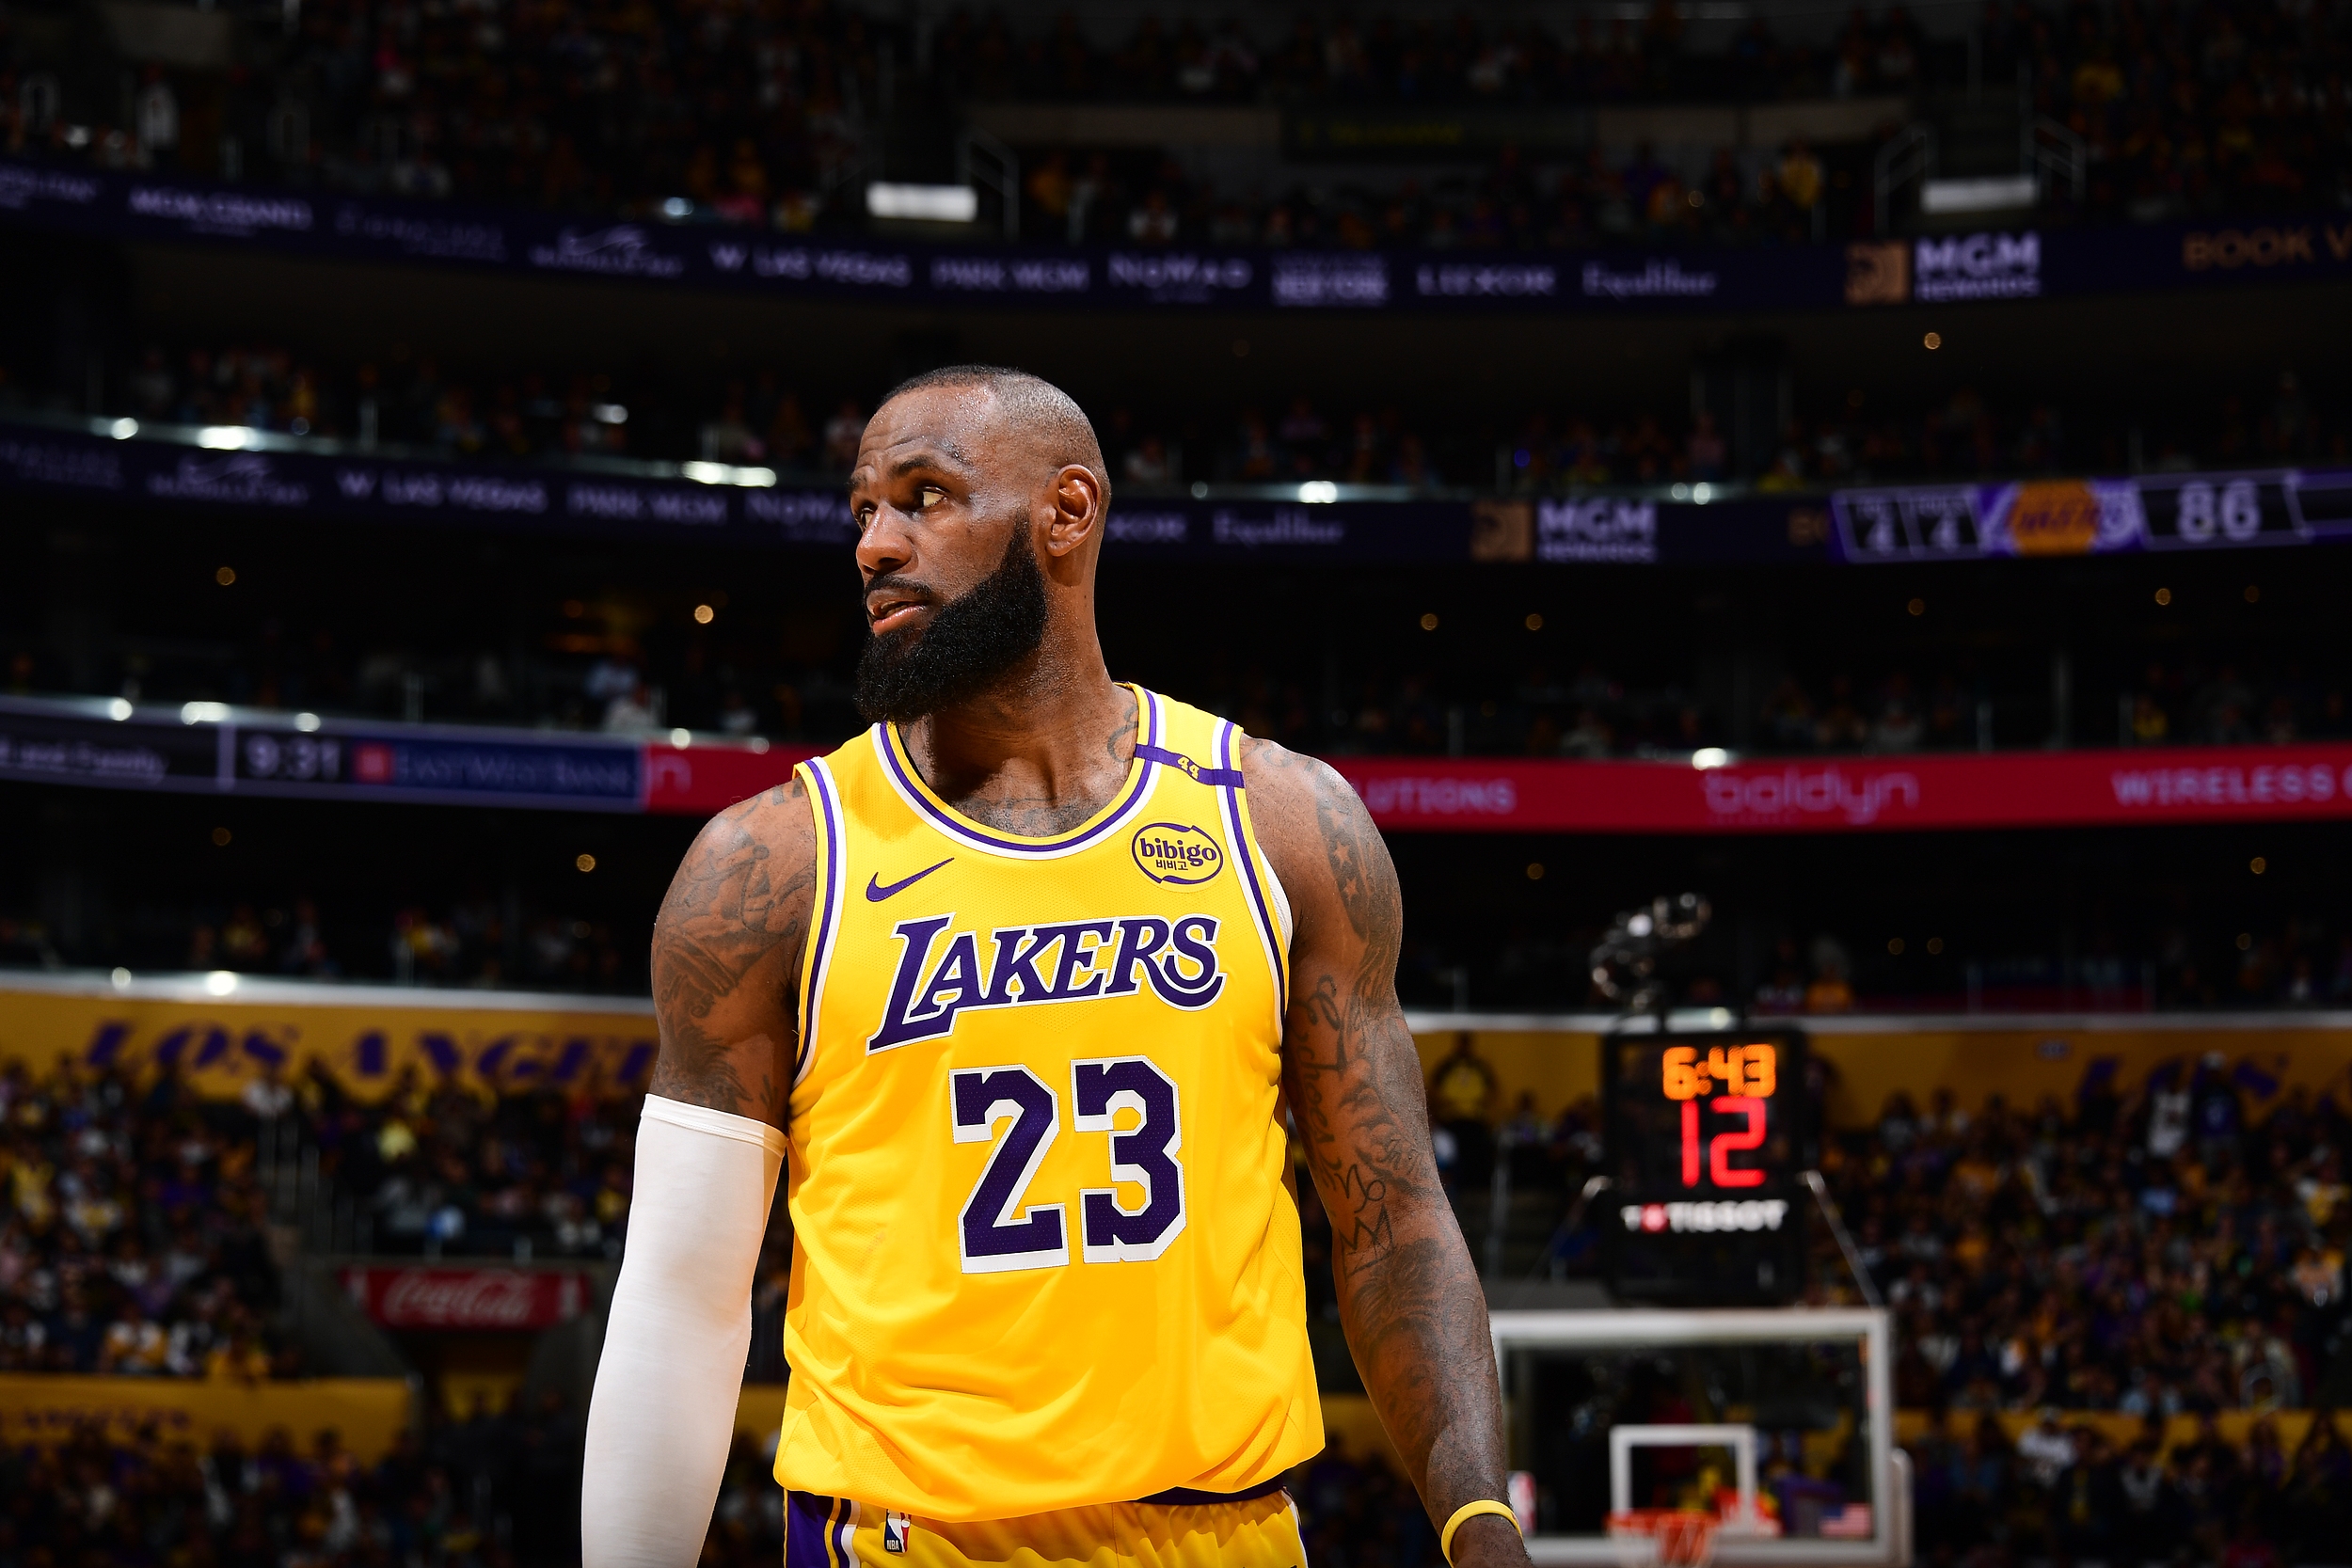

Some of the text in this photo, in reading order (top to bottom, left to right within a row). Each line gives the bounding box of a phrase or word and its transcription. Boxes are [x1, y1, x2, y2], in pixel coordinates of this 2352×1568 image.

[1915, 230, 2042, 277] MGM
[2181, 224, 2314, 274] BOOK
[1536, 496, 1657, 543] MGM
[2175, 479, 2262, 543] 86
[246, 735, 342, 780] 9:31
[1178, 756, 1201, 780] 44
[2111, 763, 2337, 806] WIRELESS
[1139, 837, 1217, 867] bibigo
[1155, 860, 1189, 871] 비비고
[866, 912, 1227, 1055] LAKERS
[85, 1018, 300, 1075] LOS
[1662, 1043, 1776, 1101] 6:43
[948, 1054, 1187, 1274] 23
[1680, 1096, 1768, 1189] 12
[1667, 1199, 1788, 1233] TISSOT
[886, 1539, 900, 1551] NBA
